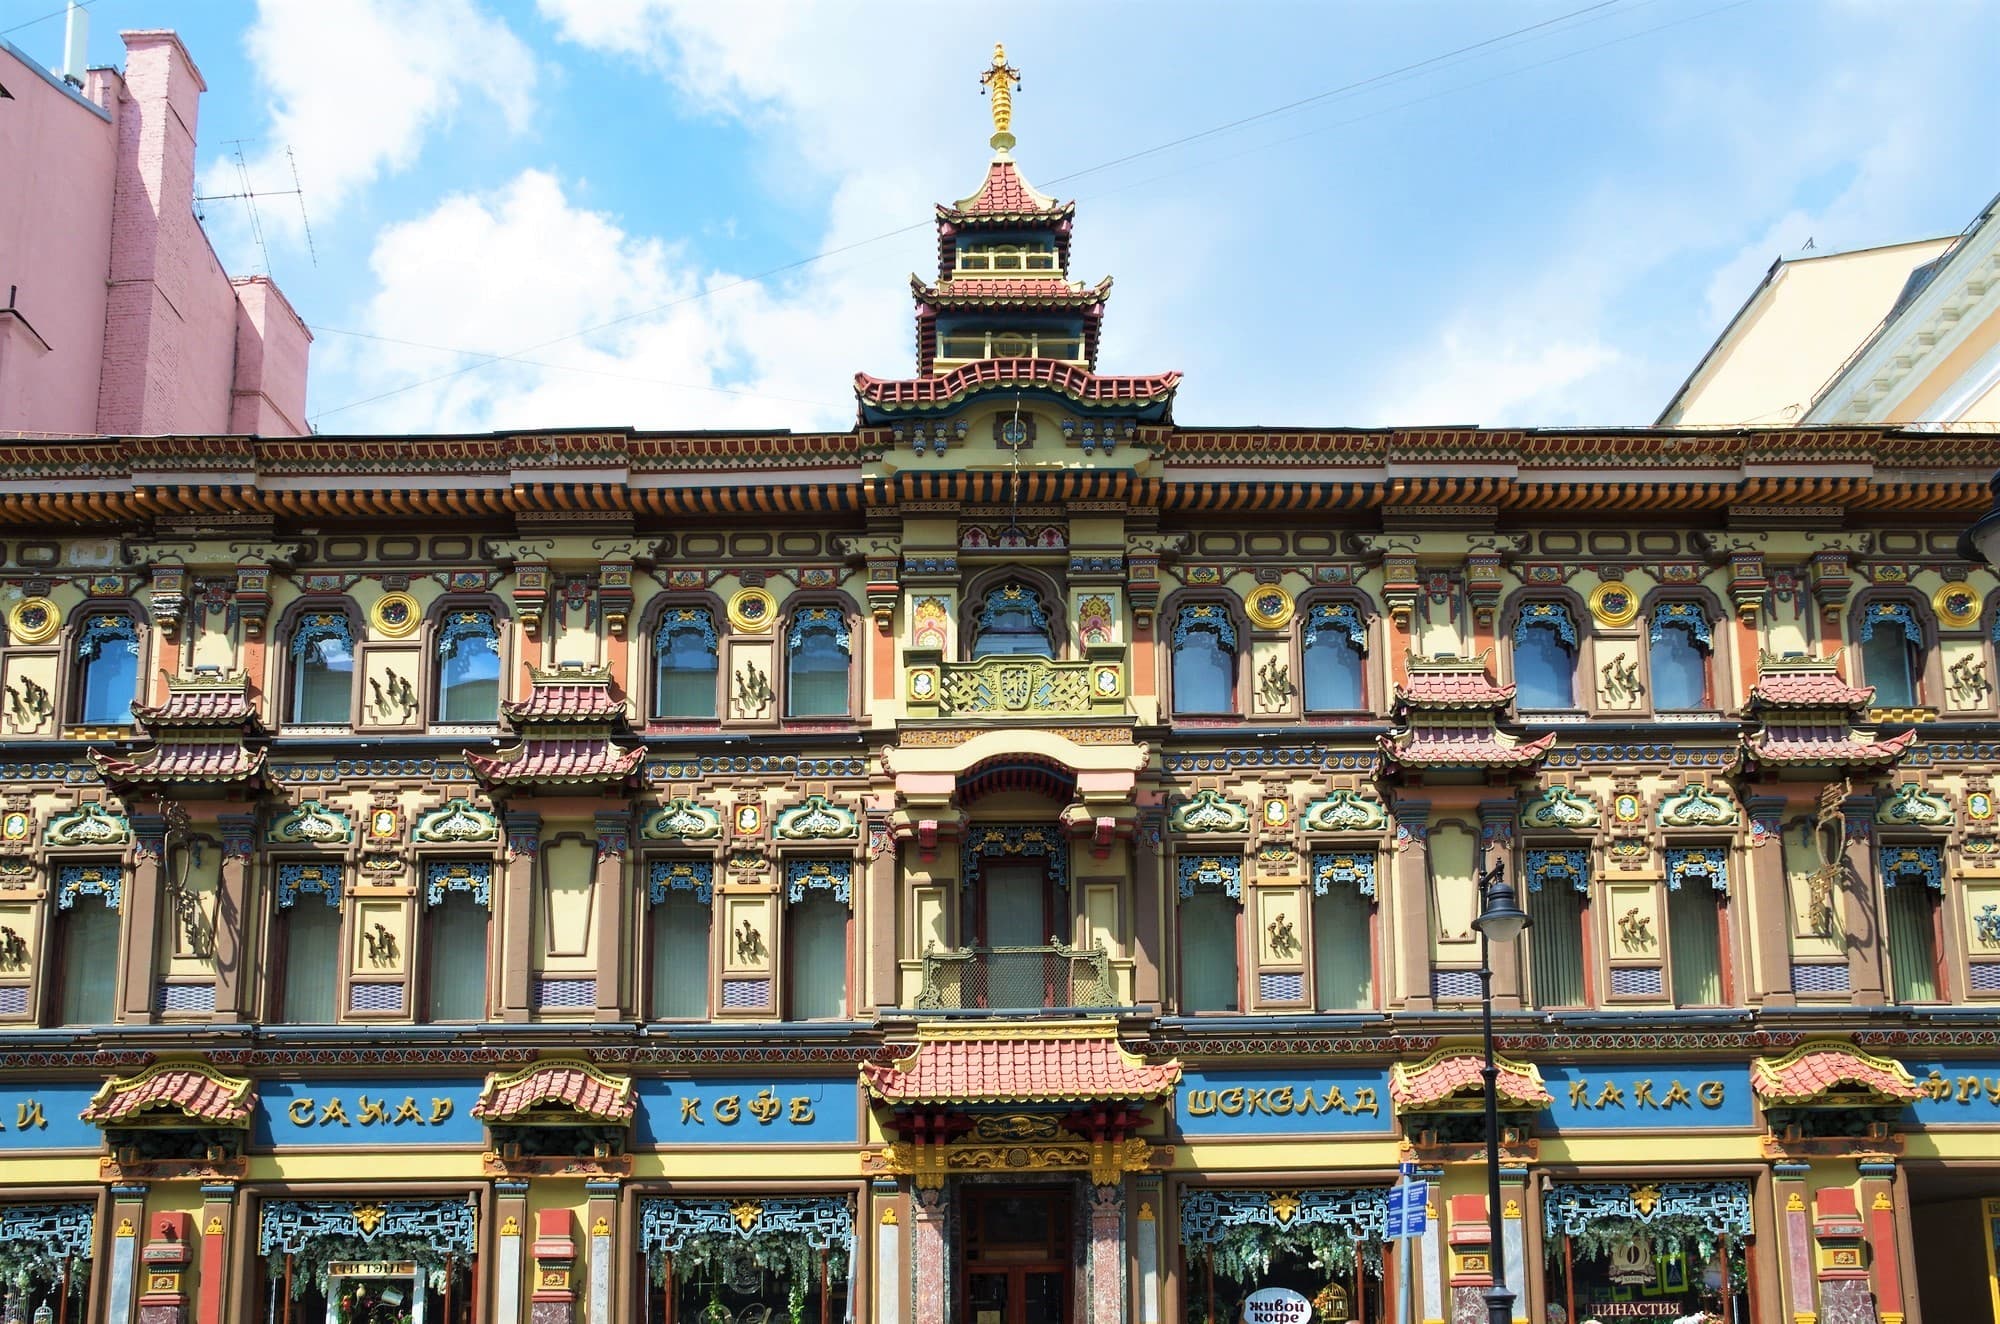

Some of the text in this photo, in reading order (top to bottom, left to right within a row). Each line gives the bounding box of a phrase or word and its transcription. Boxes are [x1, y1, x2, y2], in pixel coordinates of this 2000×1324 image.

[681, 1089, 816, 1123] КОФЕ
[1187, 1086, 1380, 1116] ШОКОЛАД
[1569, 1079, 1726, 1110] КАКАО
[288, 1095, 455, 1125] САХАР
[1249, 1299, 1305, 1312] живой
[1254, 1312, 1299, 1324] кофе
